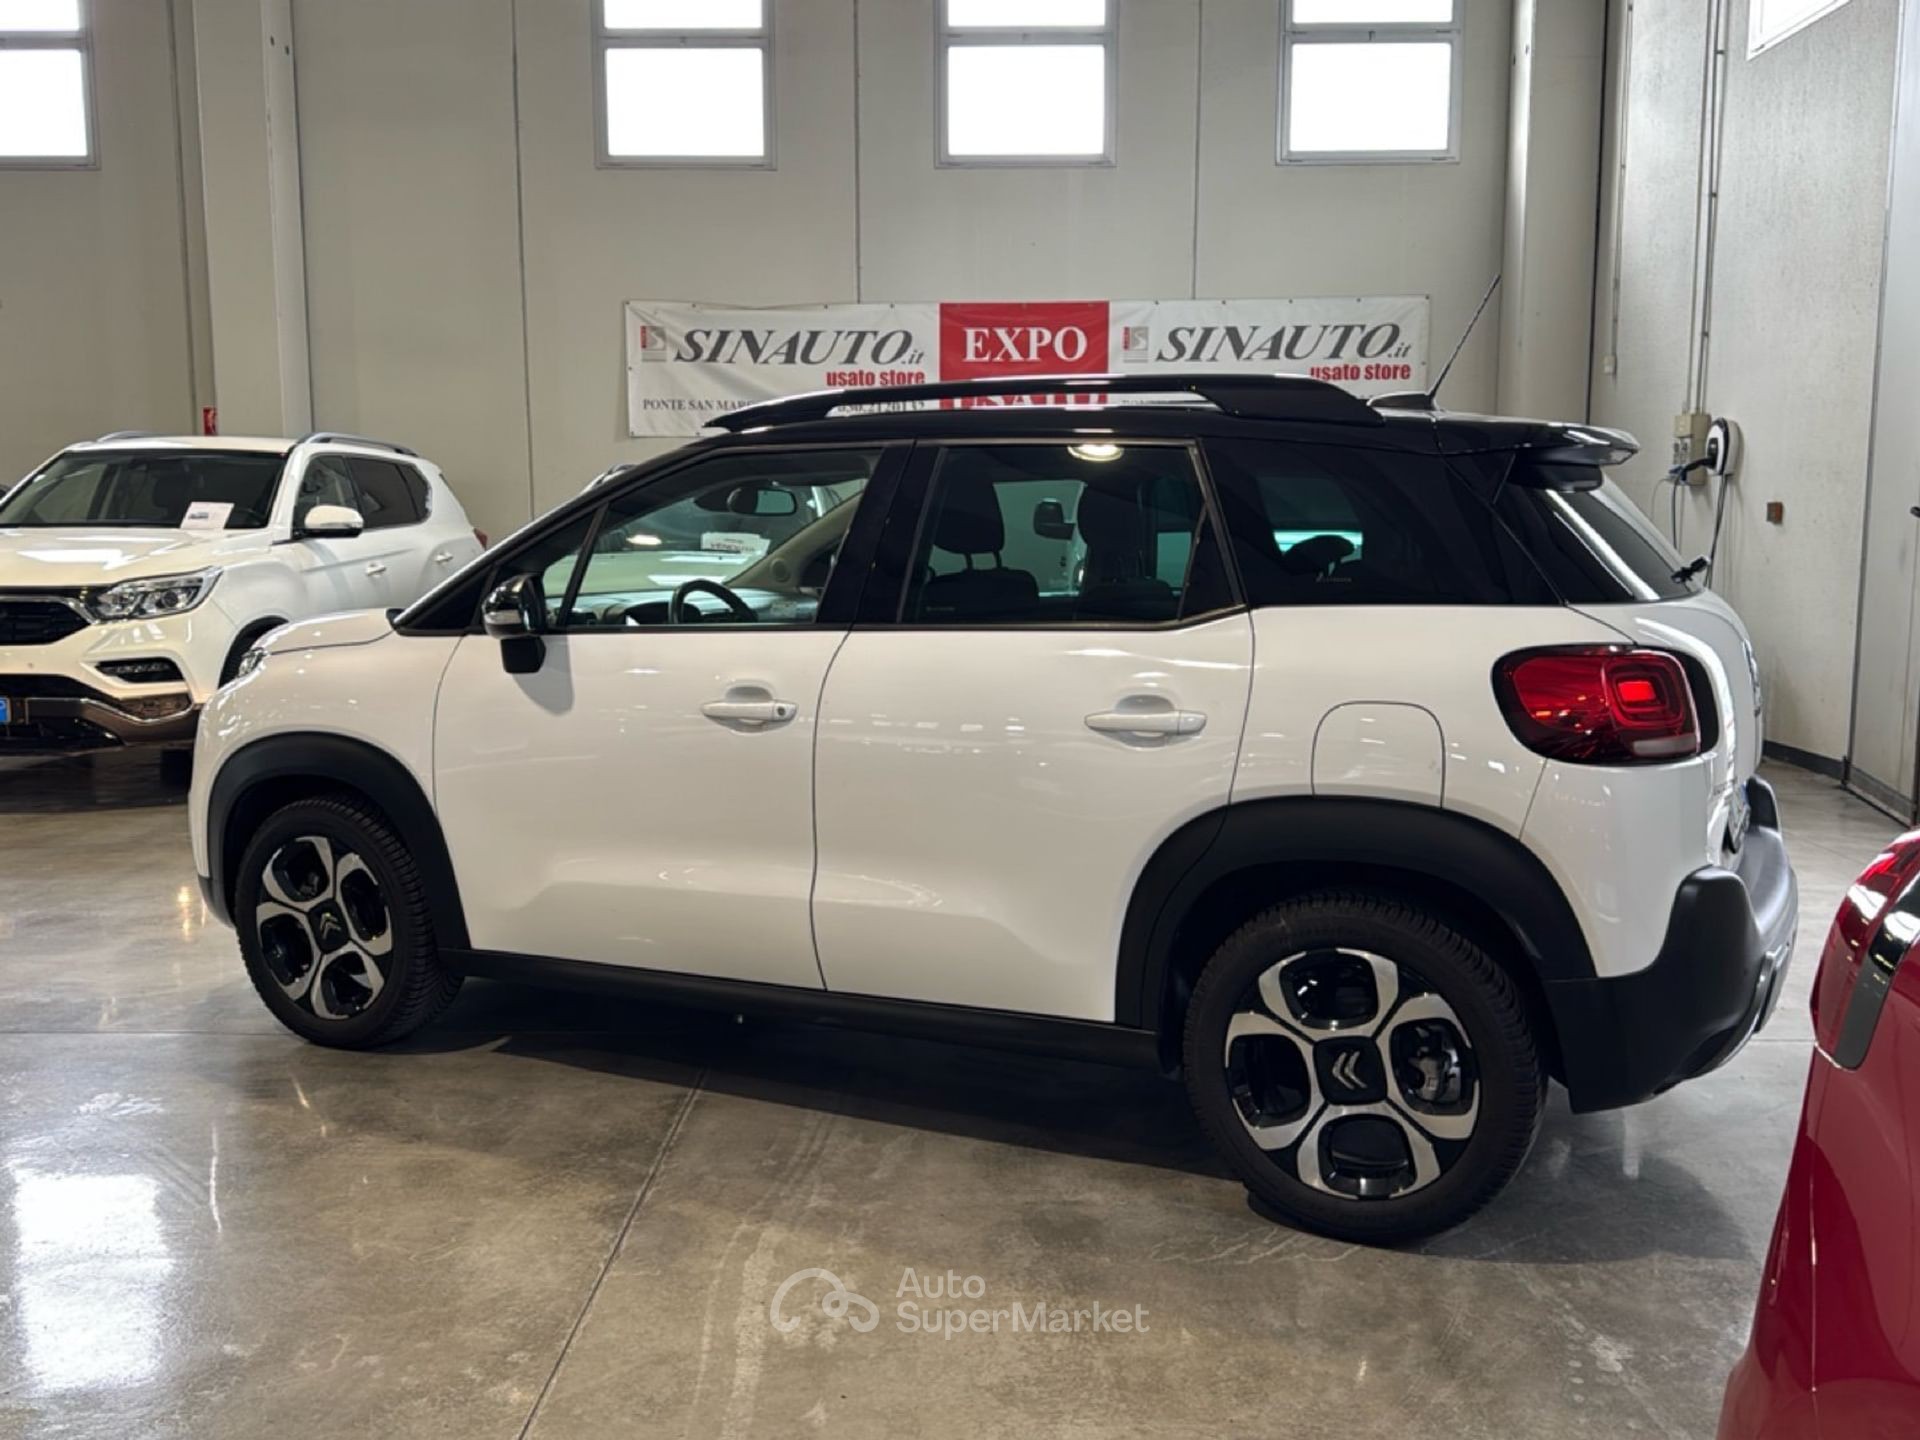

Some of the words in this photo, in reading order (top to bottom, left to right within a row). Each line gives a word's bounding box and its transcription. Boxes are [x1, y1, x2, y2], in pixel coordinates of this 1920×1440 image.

[673, 328, 924, 365] SINAUTO.it
[963, 326, 1087, 362] EXPO
[1155, 323, 1411, 362] SINAUTO.it
[826, 369, 876, 387] usato
[879, 369, 925, 386] store
[1310, 364, 1361, 381] usato
[1363, 363, 1411, 380] store
[643, 399, 686, 411] PONTE
[688, 399, 713, 411] SAN
